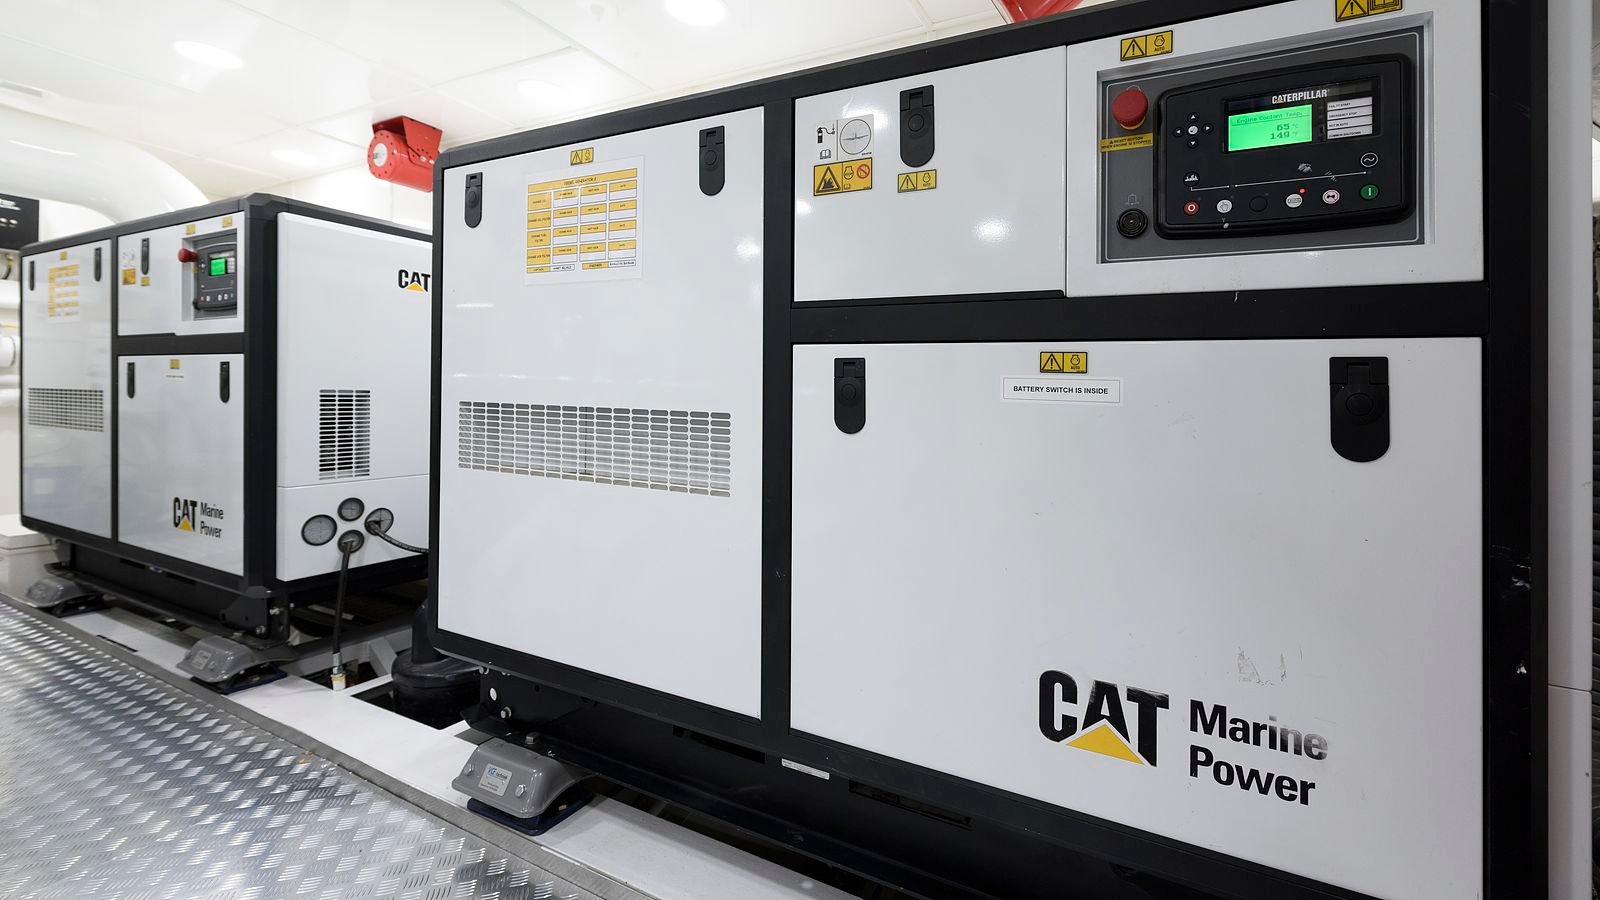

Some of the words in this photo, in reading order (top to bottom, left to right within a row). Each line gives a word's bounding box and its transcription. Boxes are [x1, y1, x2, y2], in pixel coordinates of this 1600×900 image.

[1272, 89, 1328, 104] CATERPILLAR
[1270, 131, 1290, 140] 149
[1276, 123, 1290, 131] 65
[398, 269, 431, 292] CAT
[173, 496, 198, 532] CAT
[200, 502, 224, 520] Marine
[200, 520, 222, 538] Power
[1038, 669, 1170, 767] CAT
[1189, 699, 1329, 762] Marine
[1189, 745, 1316, 807] Power
